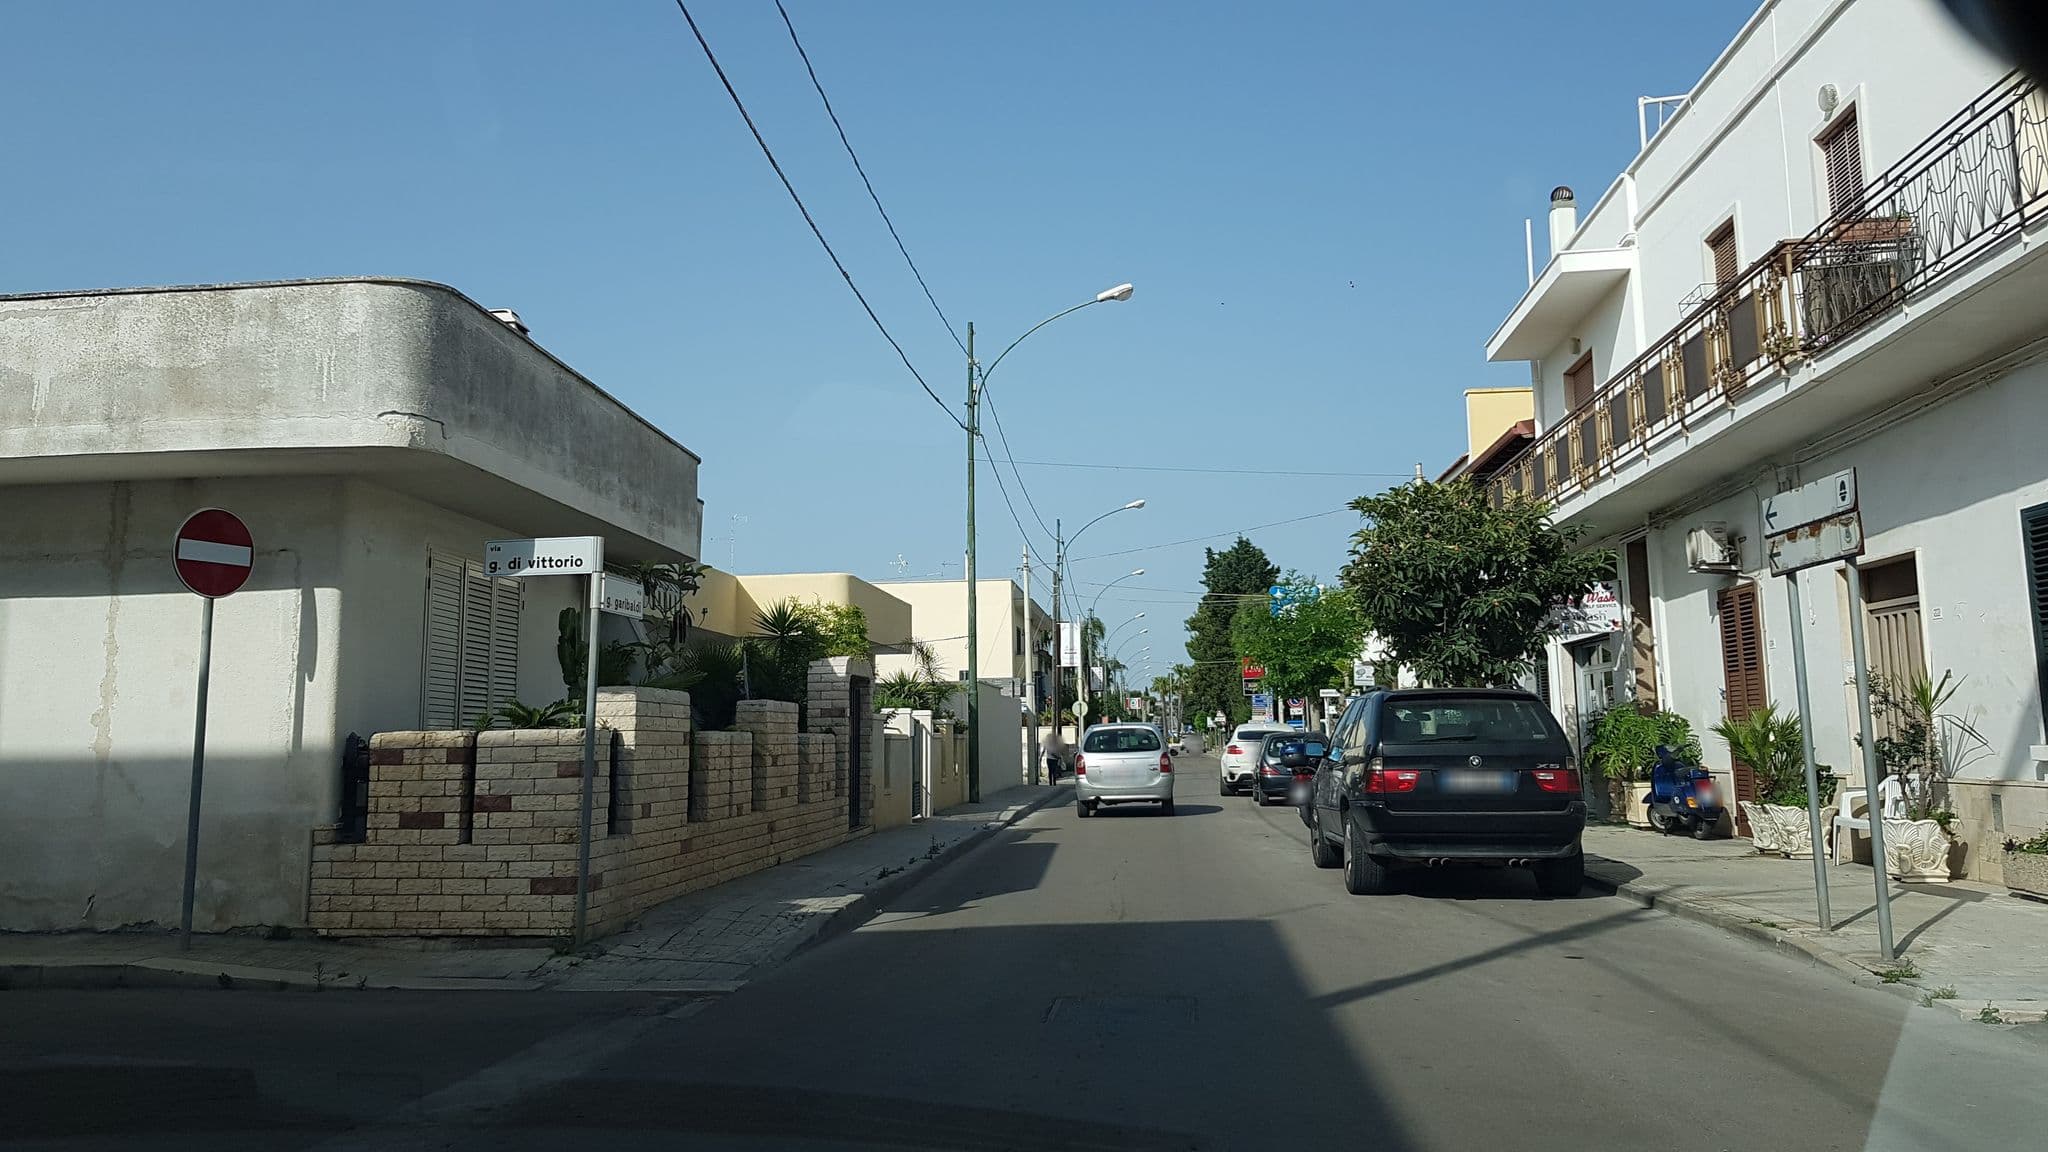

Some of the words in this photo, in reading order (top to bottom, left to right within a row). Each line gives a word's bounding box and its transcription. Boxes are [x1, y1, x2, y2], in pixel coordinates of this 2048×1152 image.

[489, 560, 502, 573] g.
[508, 557, 521, 570] di
[527, 555, 584, 569] vittorio
[614, 598, 642, 613] garibaldi
